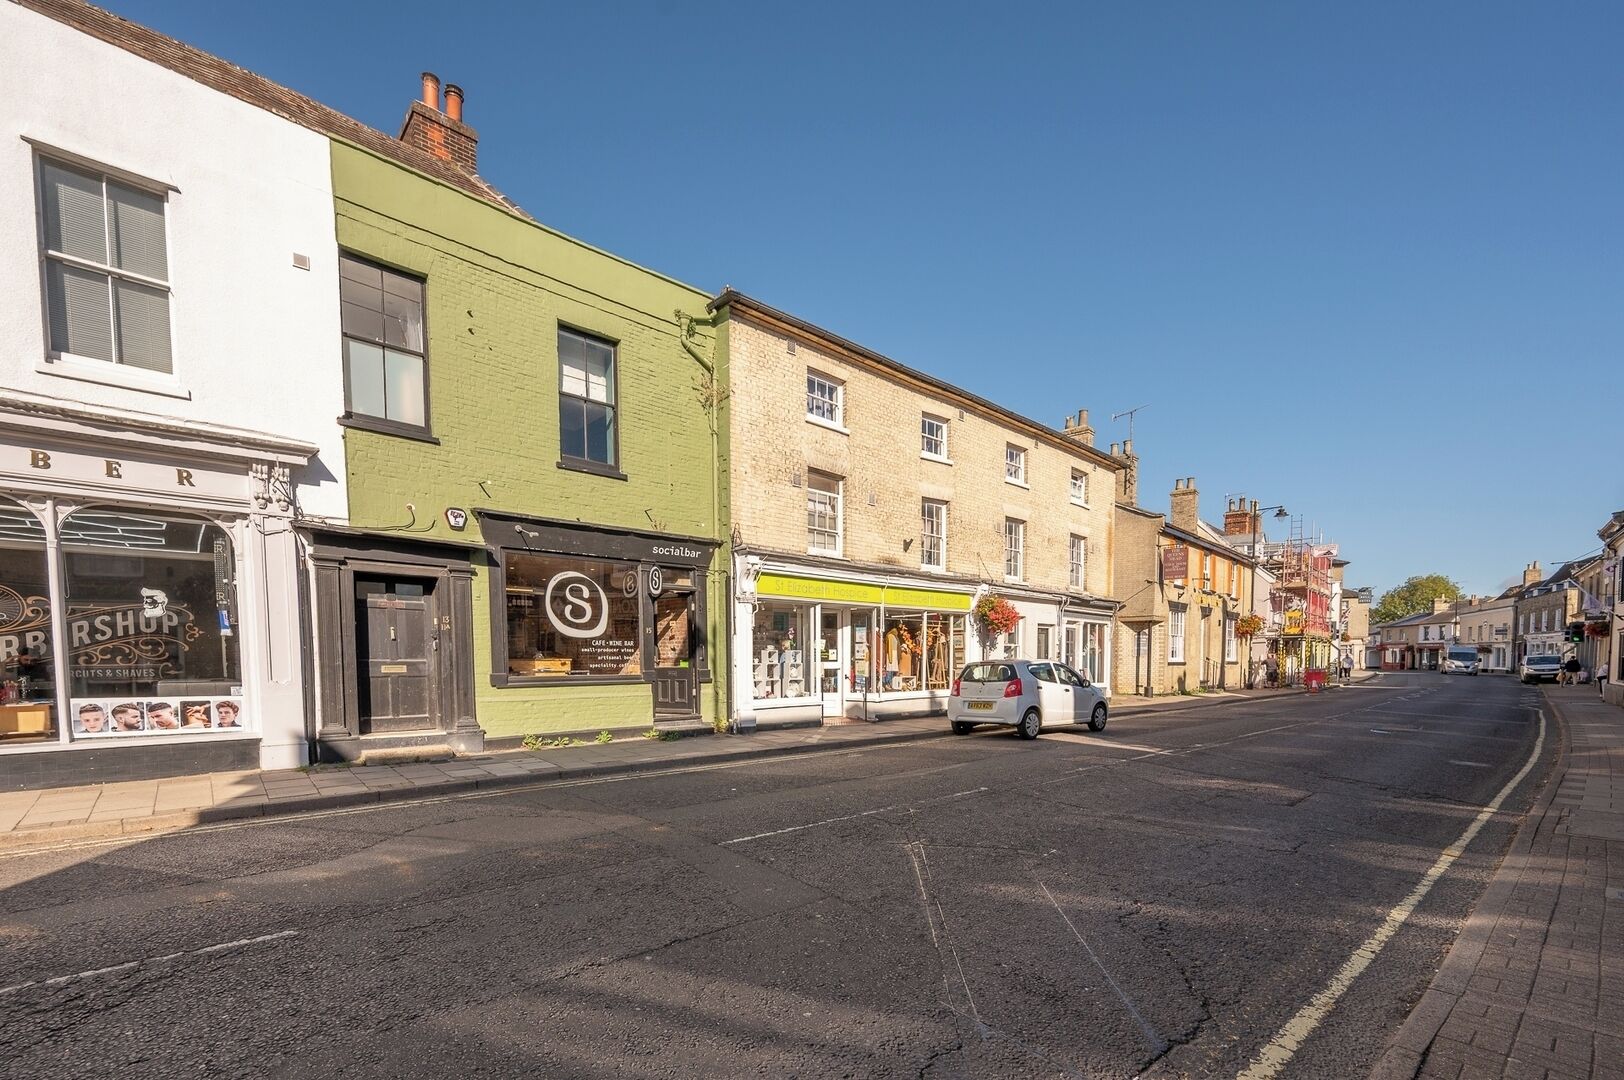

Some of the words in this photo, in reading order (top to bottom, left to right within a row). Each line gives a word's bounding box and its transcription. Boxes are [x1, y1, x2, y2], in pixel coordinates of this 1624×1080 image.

[652, 545, 702, 559] socialbar
[775, 580, 784, 591] St
[787, 582, 830, 596] Elizabeth
[833, 586, 869, 600] Hospice
[564, 583, 592, 624] S
[115, 668, 156, 678] SHAVES
